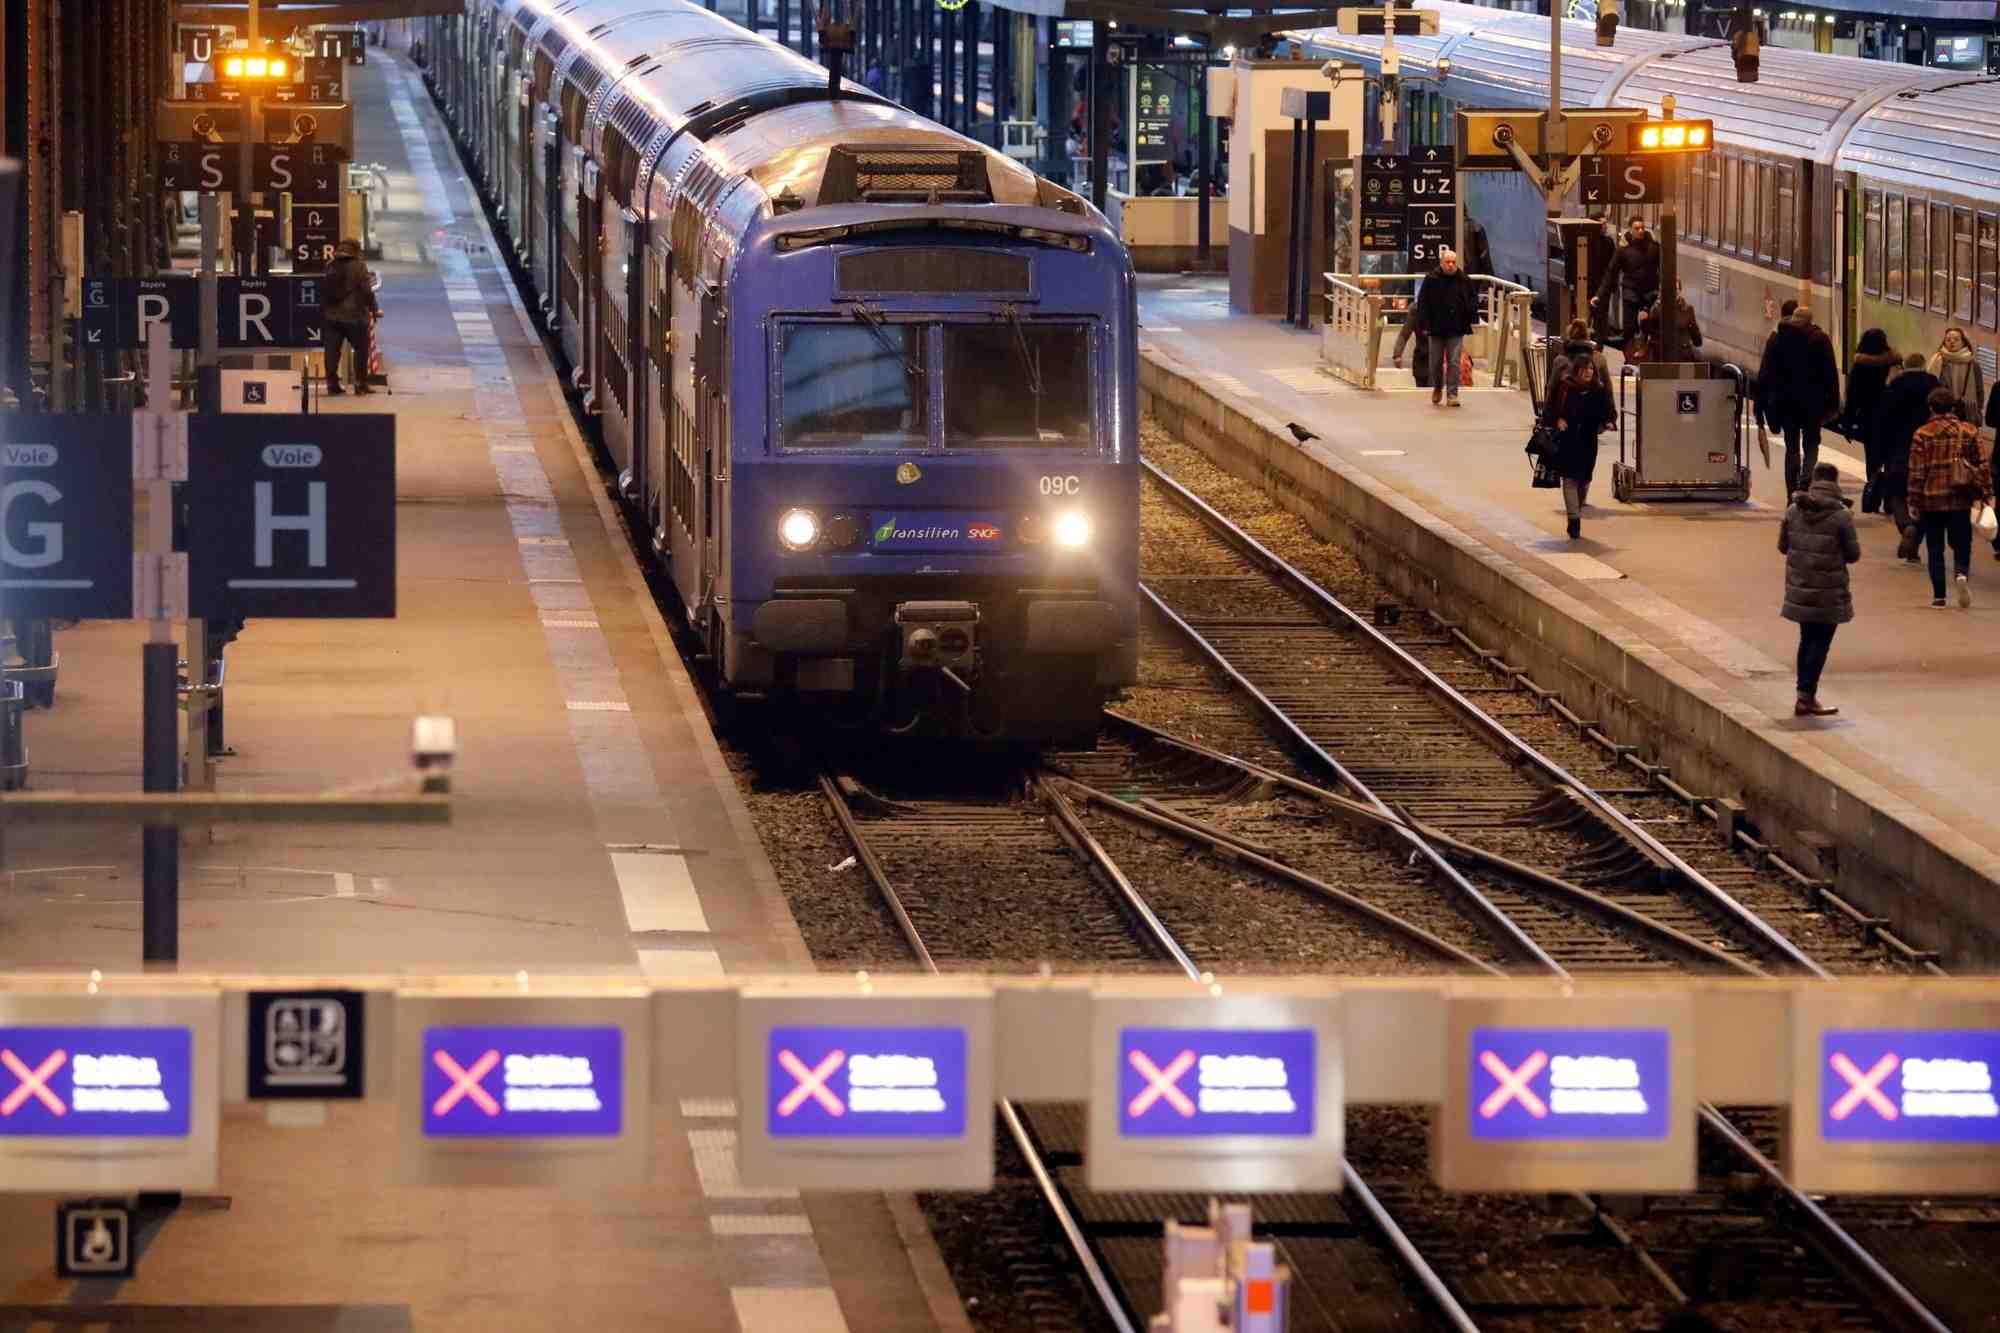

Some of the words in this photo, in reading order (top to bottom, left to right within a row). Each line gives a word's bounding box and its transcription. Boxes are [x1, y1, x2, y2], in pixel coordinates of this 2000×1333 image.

[193, 38, 212, 62] U
[200, 153, 224, 188] S
[269, 154, 293, 189] S
[1413, 178, 1426, 194] U
[1438, 178, 1451, 194] Z
[1623, 165, 1647, 200] S
[298, 244, 309, 260] S
[322, 244, 335, 260] R
[1413, 244, 1426, 260] S
[89, 289, 105, 305] G
[301, 288, 315, 304] H
[137, 294, 170, 342] P
[239, 293, 274, 341] R
[6, 447, 50, 465] Voie
[270, 447, 313, 465] Voie
[1038, 475, 1080, 496] 09C
[0, 479, 64, 568] G
[253, 481, 328, 568] H
[880, 525, 960, 540] Transilien
[967, 528, 1002, 539] SNCF
